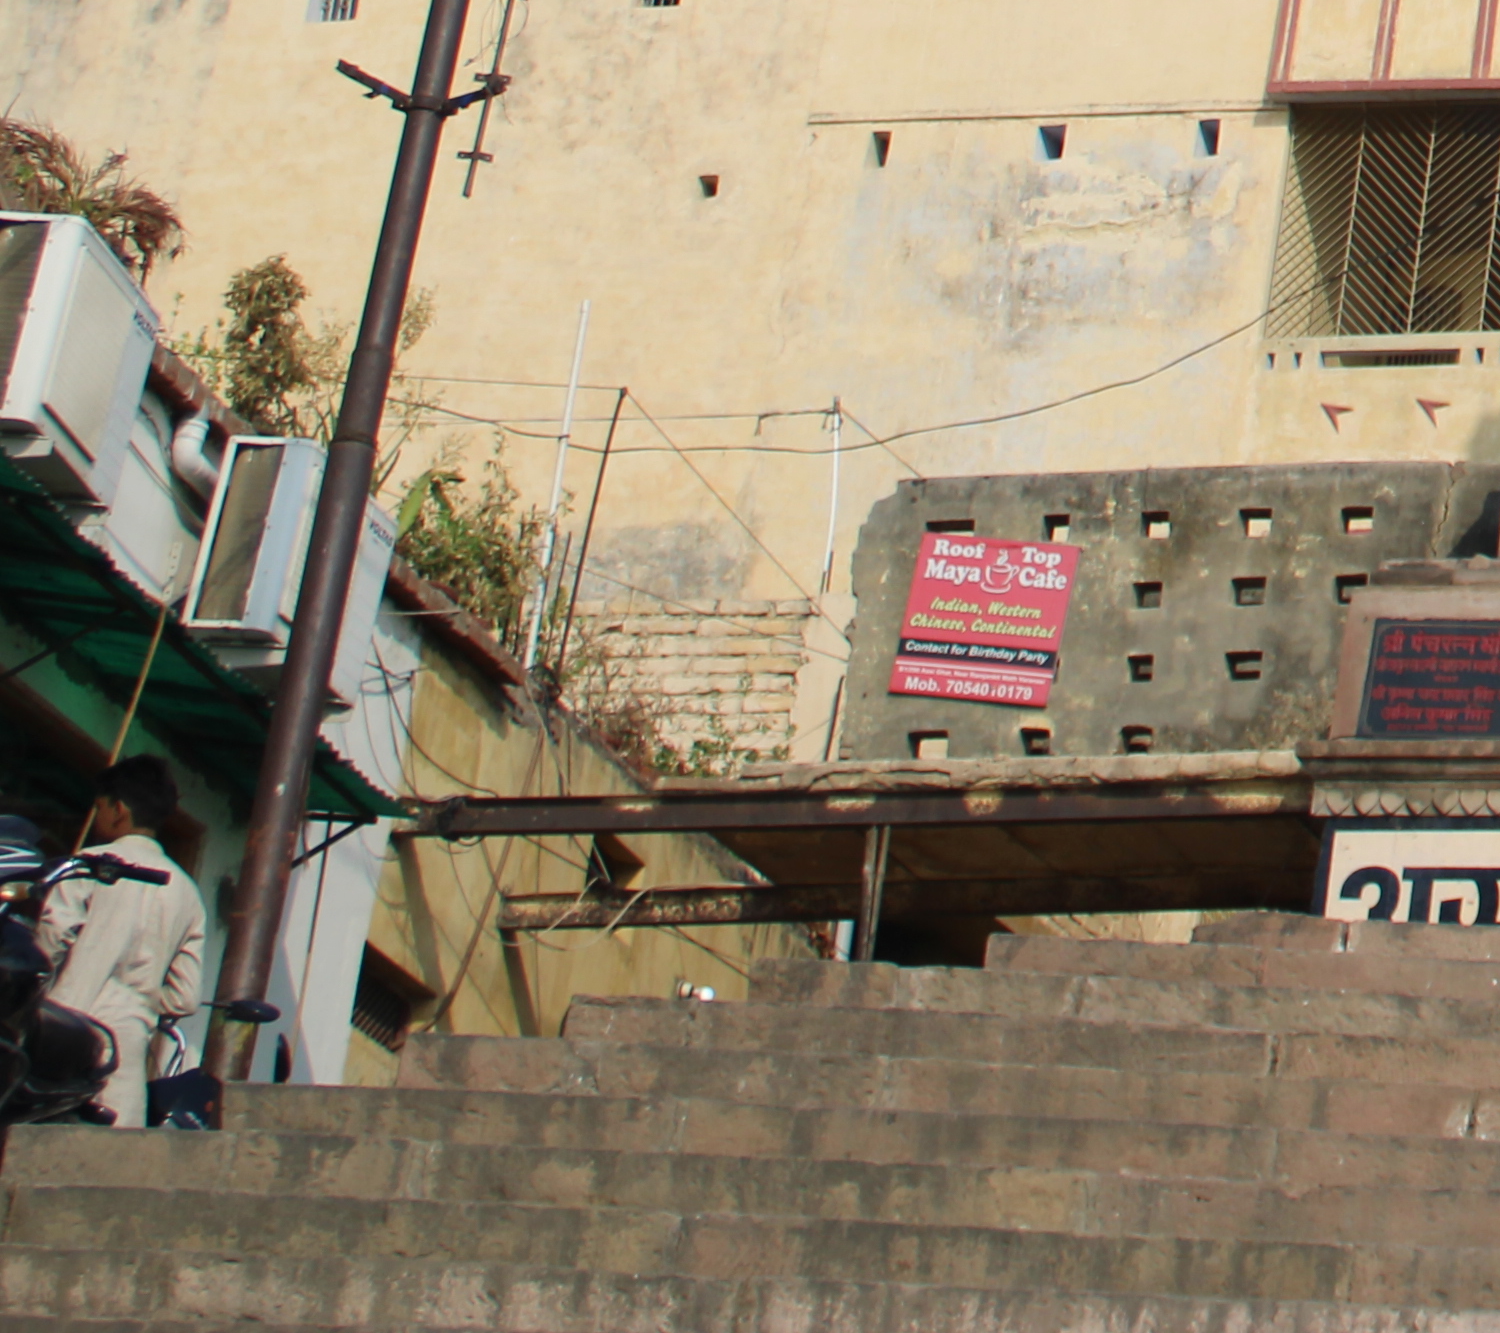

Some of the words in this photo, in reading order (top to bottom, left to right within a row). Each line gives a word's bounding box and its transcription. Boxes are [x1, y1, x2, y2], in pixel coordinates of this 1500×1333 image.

[933, 538, 986, 559] Roof
[1021, 546, 1062, 568] Top
[924, 558, 981, 585] Maya
[1018, 566, 1067, 590] Cafe
[930, 597, 982, 615] Indian,
[988, 601, 1042, 619] Western
[910, 612, 966, 632] Chinese,
[970, 619, 1056, 639] Continental
[905, 639, 950, 654] Contact
[950, 644, 968, 656] for
[968, 645, 1017, 662] Birthday
[1018, 649, 1049, 665] Party
[905, 676, 940, 692] Mob.
